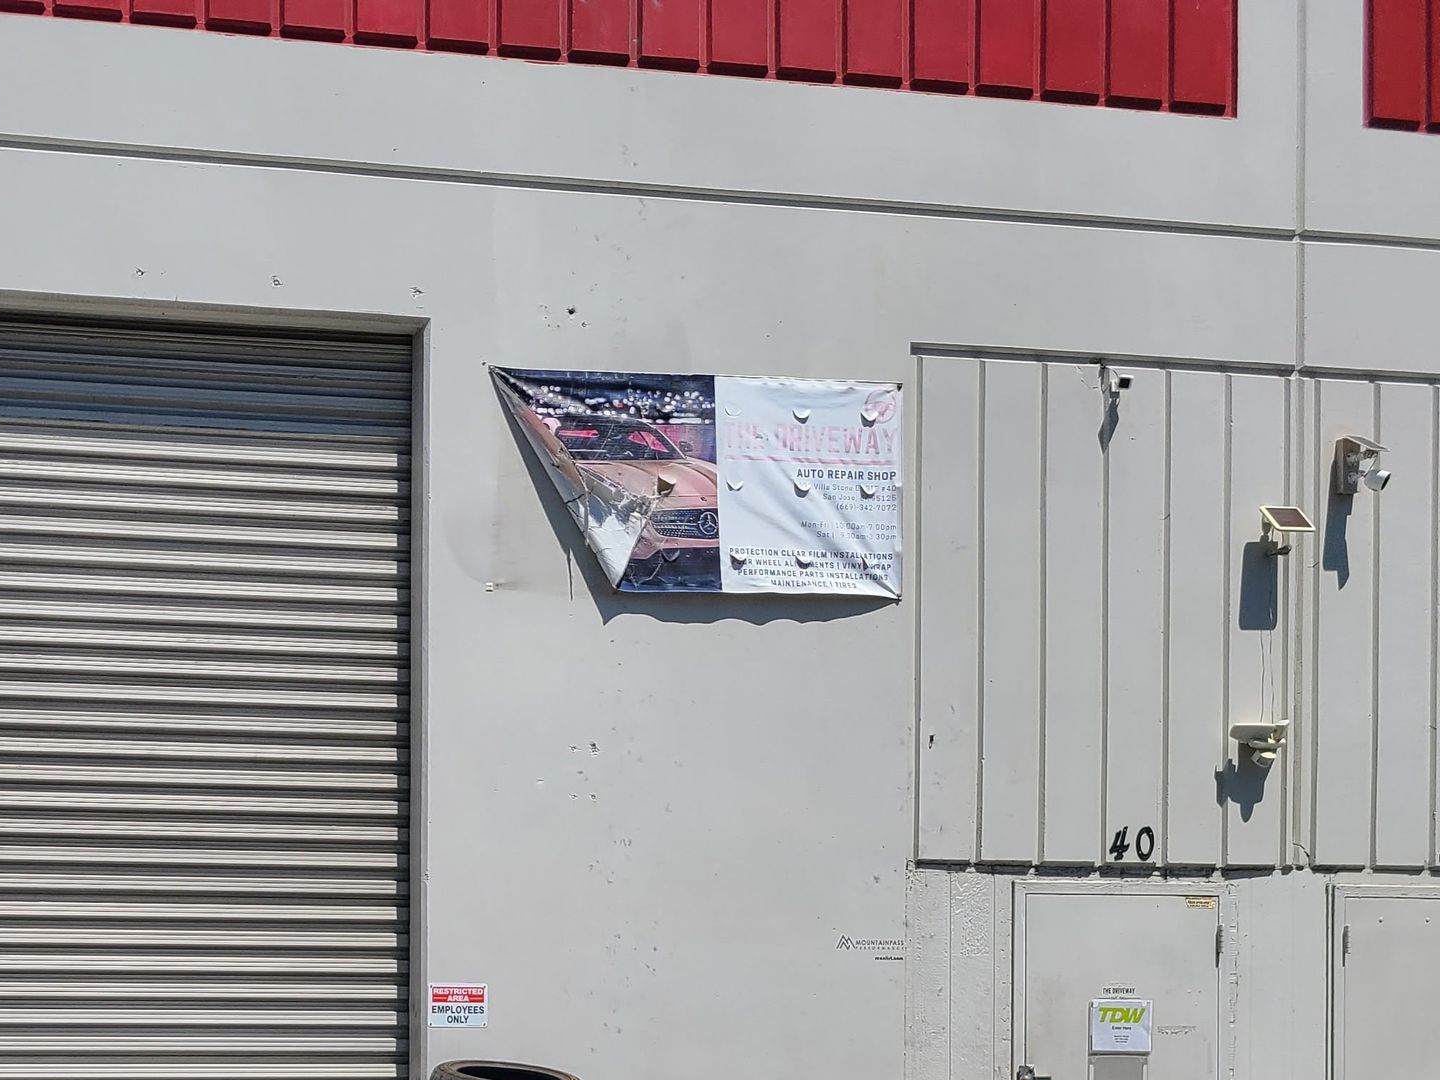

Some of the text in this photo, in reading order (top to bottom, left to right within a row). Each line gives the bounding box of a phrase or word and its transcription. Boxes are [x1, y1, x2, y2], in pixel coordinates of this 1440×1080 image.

[775, 423, 898, 454] DRIVEWAY
[797, 469, 896, 481] AUTO REPAIR SHOP
[823, 493, 837, 501] San
[729, 547, 779, 556] PROTECTION
[781, 549, 806, 557] CLEAR
[808, 551, 827, 559] FILM
[756, 559, 782, 567] WHEEL
[785, 560, 835, 569] ALIMENTS
[738, 569, 797, 577] PERFORMANCE
[827, 572, 889, 581] INSTALLATIONS
[771, 579, 828, 588] MAINTENANCE
[1109, 826, 1154, 861] 40
[431, 1005, 485, 1014] EMPLOYEES
[1098, 1007, 1146, 1023] TDW
[446, 1015, 469, 1024] ONLY
